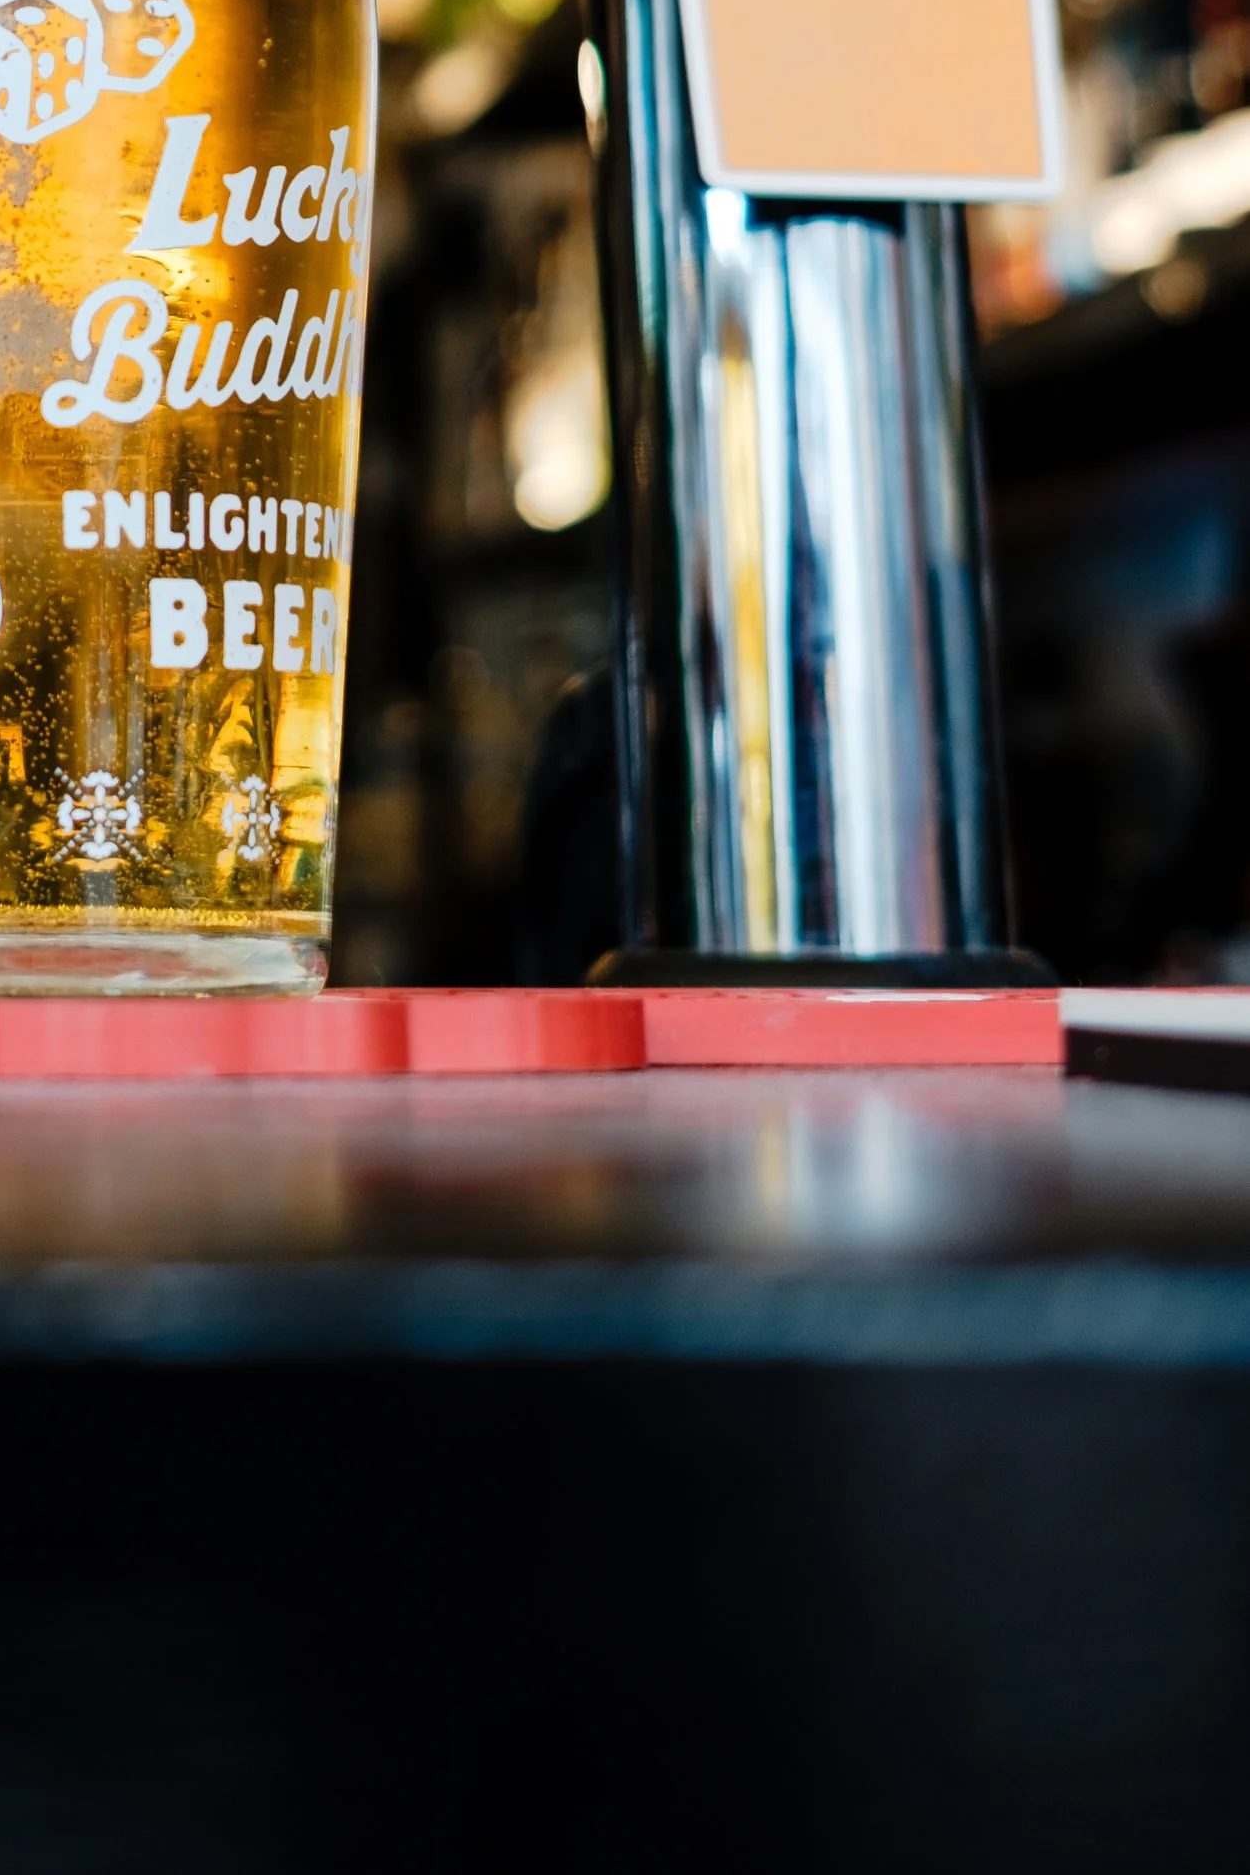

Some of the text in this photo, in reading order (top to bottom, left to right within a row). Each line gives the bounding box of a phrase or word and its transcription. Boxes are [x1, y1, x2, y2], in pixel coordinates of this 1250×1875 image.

[40, 279, 363, 428] Buddh
[62, 490, 354, 563] ENLIGHTEN
[150, 577, 337, 675] BEER
